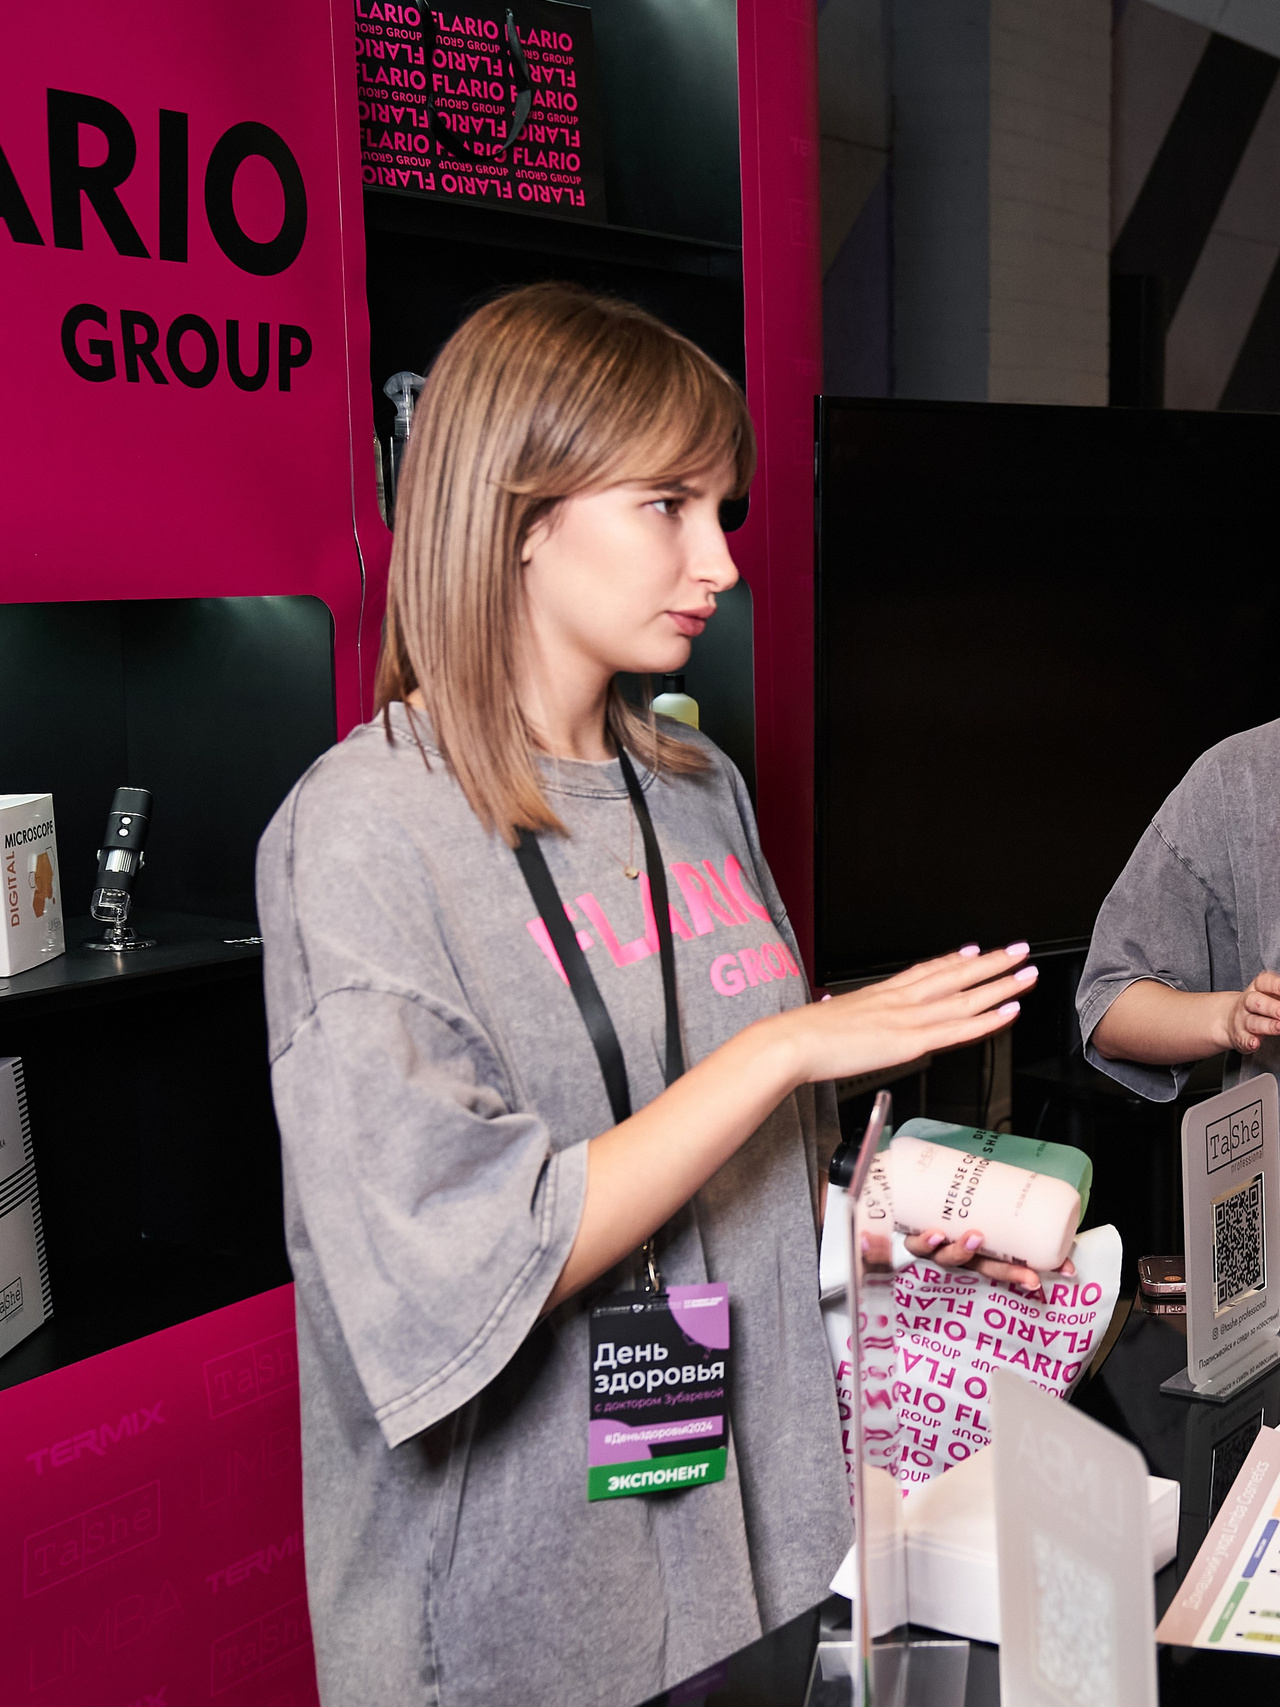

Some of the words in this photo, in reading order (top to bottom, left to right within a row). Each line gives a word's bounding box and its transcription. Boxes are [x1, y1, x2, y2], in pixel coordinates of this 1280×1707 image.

[356, 0, 421, 27] LARIO
[386, 27, 422, 41] GROUP
[436, 34, 464, 48] GROU
[467, 40, 500, 54] GROUP
[542, 52, 574, 66] GROUP
[432, 49, 503, 77] FLARIO
[508, 61, 576, 88] FLAR
[358, 86, 389, 99] GROU
[391, 91, 427, 104] GROUP
[472, 102, 506, 115] GROUP
[547, 112, 579, 125] GROUP
[432, 73, 504, 101] FLARIO
[510, 84, 578, 111] FARIO
[362, 151, 393, 163] GROU
[396, 155, 431, 168] GROUP
[476, 165, 509, 177] GROUP
[550, 173, 582, 185] GROUP
[513, 147, 580, 172] FLARIO
[362, 164, 436, 191] FLARIO
[442, 173, 513, 199] FLARIO
[518, 182, 586, 207] FLARIO
[61, 303, 312, 392] GROUP
[5, 820, 53, 849] MICROSCOPE
[6, 851, 20, 927] DIGITAL
[710, 941, 800, 997] GROU
[941, 1167, 968, 1220] INTENSE
[958, 1158, 991, 1218] CONDITIO
[899, 1263, 979, 1285] ARIO
[990, 1278, 1102, 1308] LARIO
[894, 1288, 974, 1318] FLAR
[984, 1308, 1094, 1354] FLARIO
[920, 1286, 976, 1296] GROUP
[988, 1292, 1040, 1319] GROUP
[1045, 1310, 1097, 1325] GROUP
[594, 1342, 668, 1371] День
[895, 1312, 966, 1341] ARIO
[976, 1331, 1082, 1384] FLARIO
[911, 1333, 961, 1360] GROUP
[594, 1361, 725, 1395] здоровья
[594, 1402, 601, 1413] с
[603, 1395, 661, 1413] доктором
[664, 1387, 724, 1407] Зубаревой
[25, 1400, 167, 1476] TERMIX
[604, 1421, 713, 1445] #Деньздоровья2024
[901, 1409, 941, 1428] ROUP
[952, 1427, 991, 1446] ROUP
[608, 1463, 709, 1491] ЭКСПОНЕНТ
[900, 1469, 930, 1483] OUP
[1237, 1460, 1269, 1506] Cosmetics
[206, 1532, 302, 1596] TERMI
